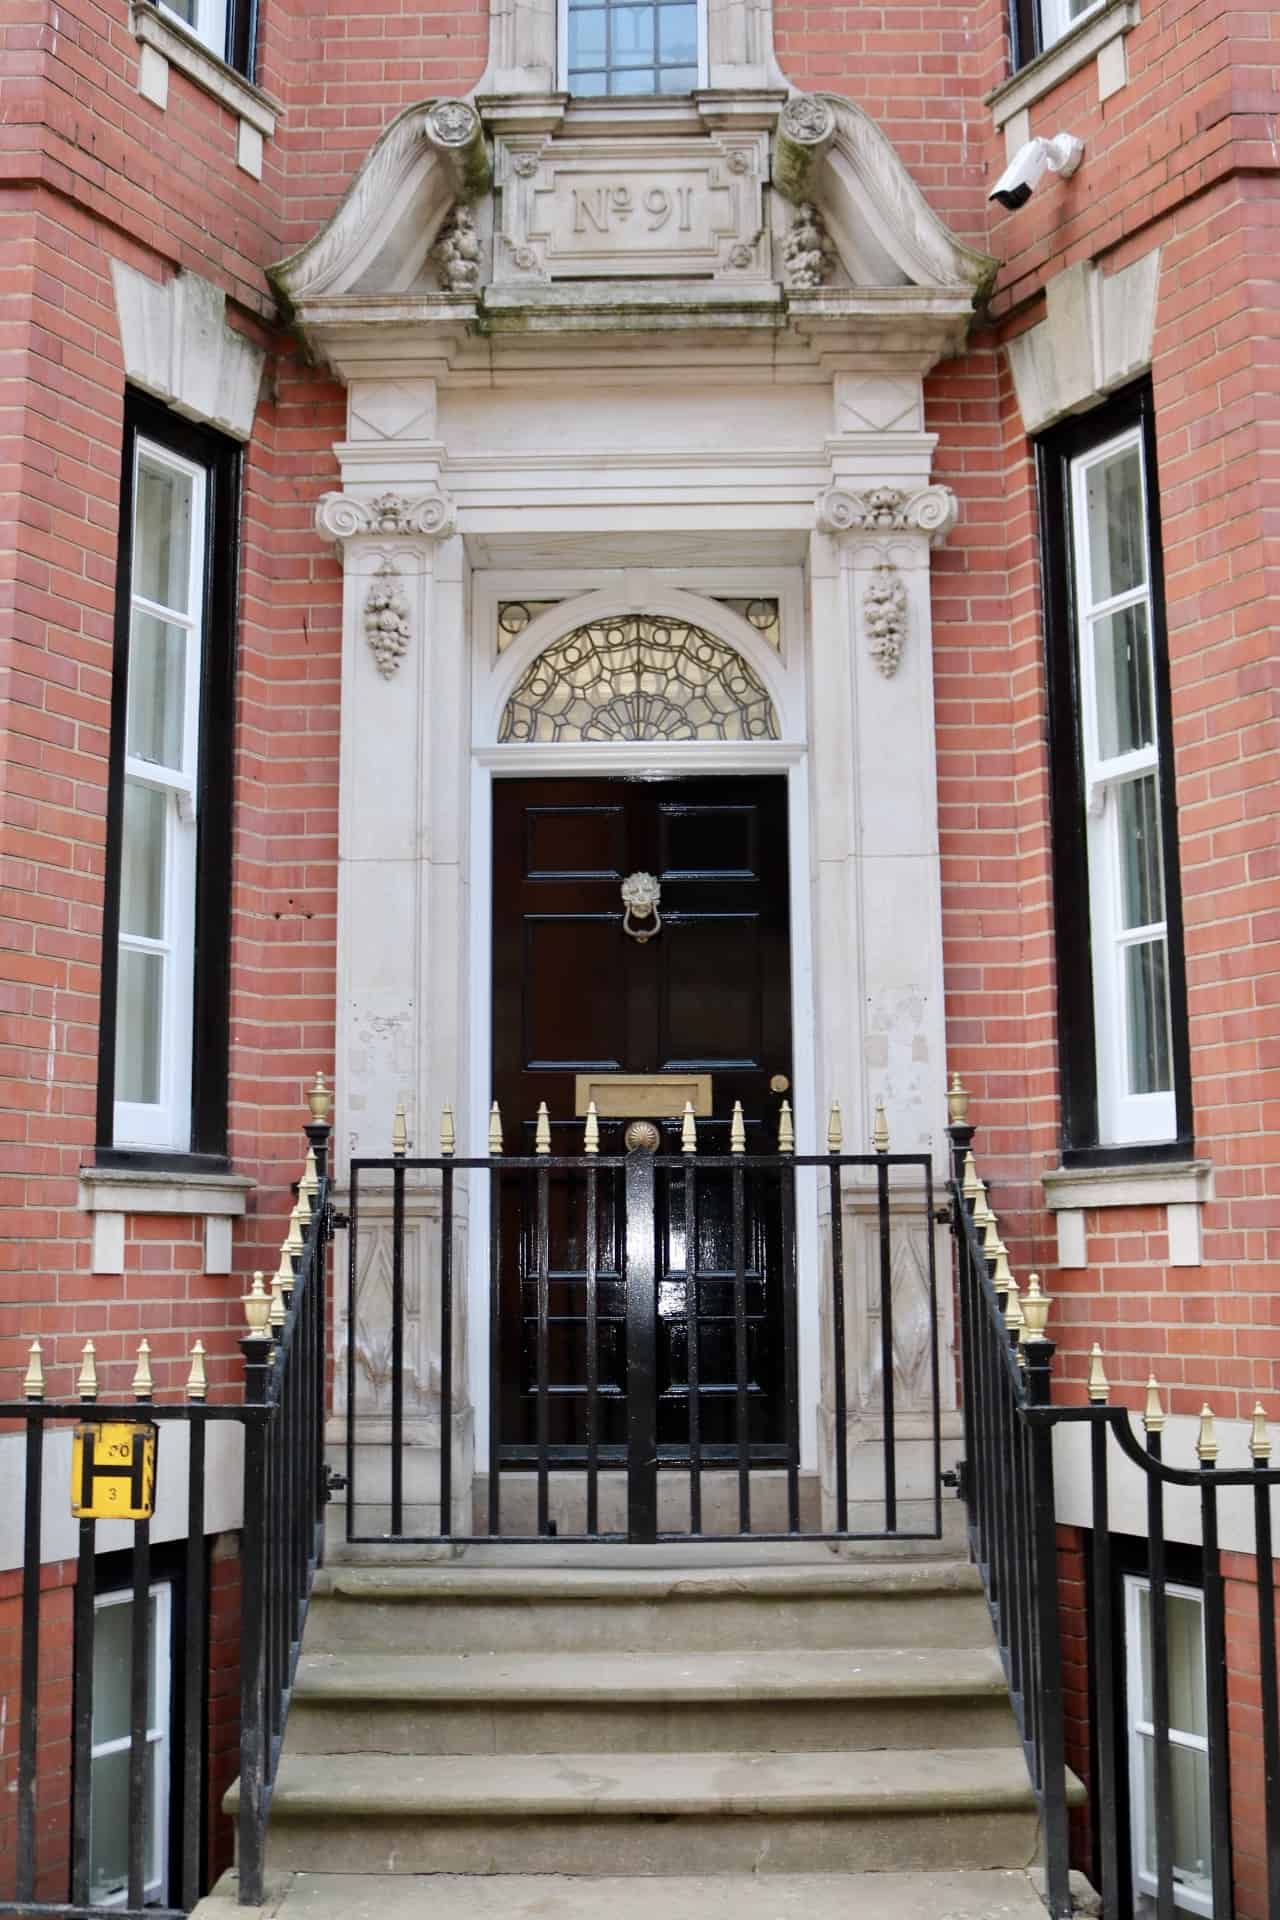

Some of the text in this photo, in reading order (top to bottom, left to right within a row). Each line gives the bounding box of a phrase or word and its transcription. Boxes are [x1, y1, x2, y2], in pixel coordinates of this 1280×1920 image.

[643, 187, 693, 232] 91
[81, 1432, 145, 1510] H
[107, 1487, 118, 1501] 3
